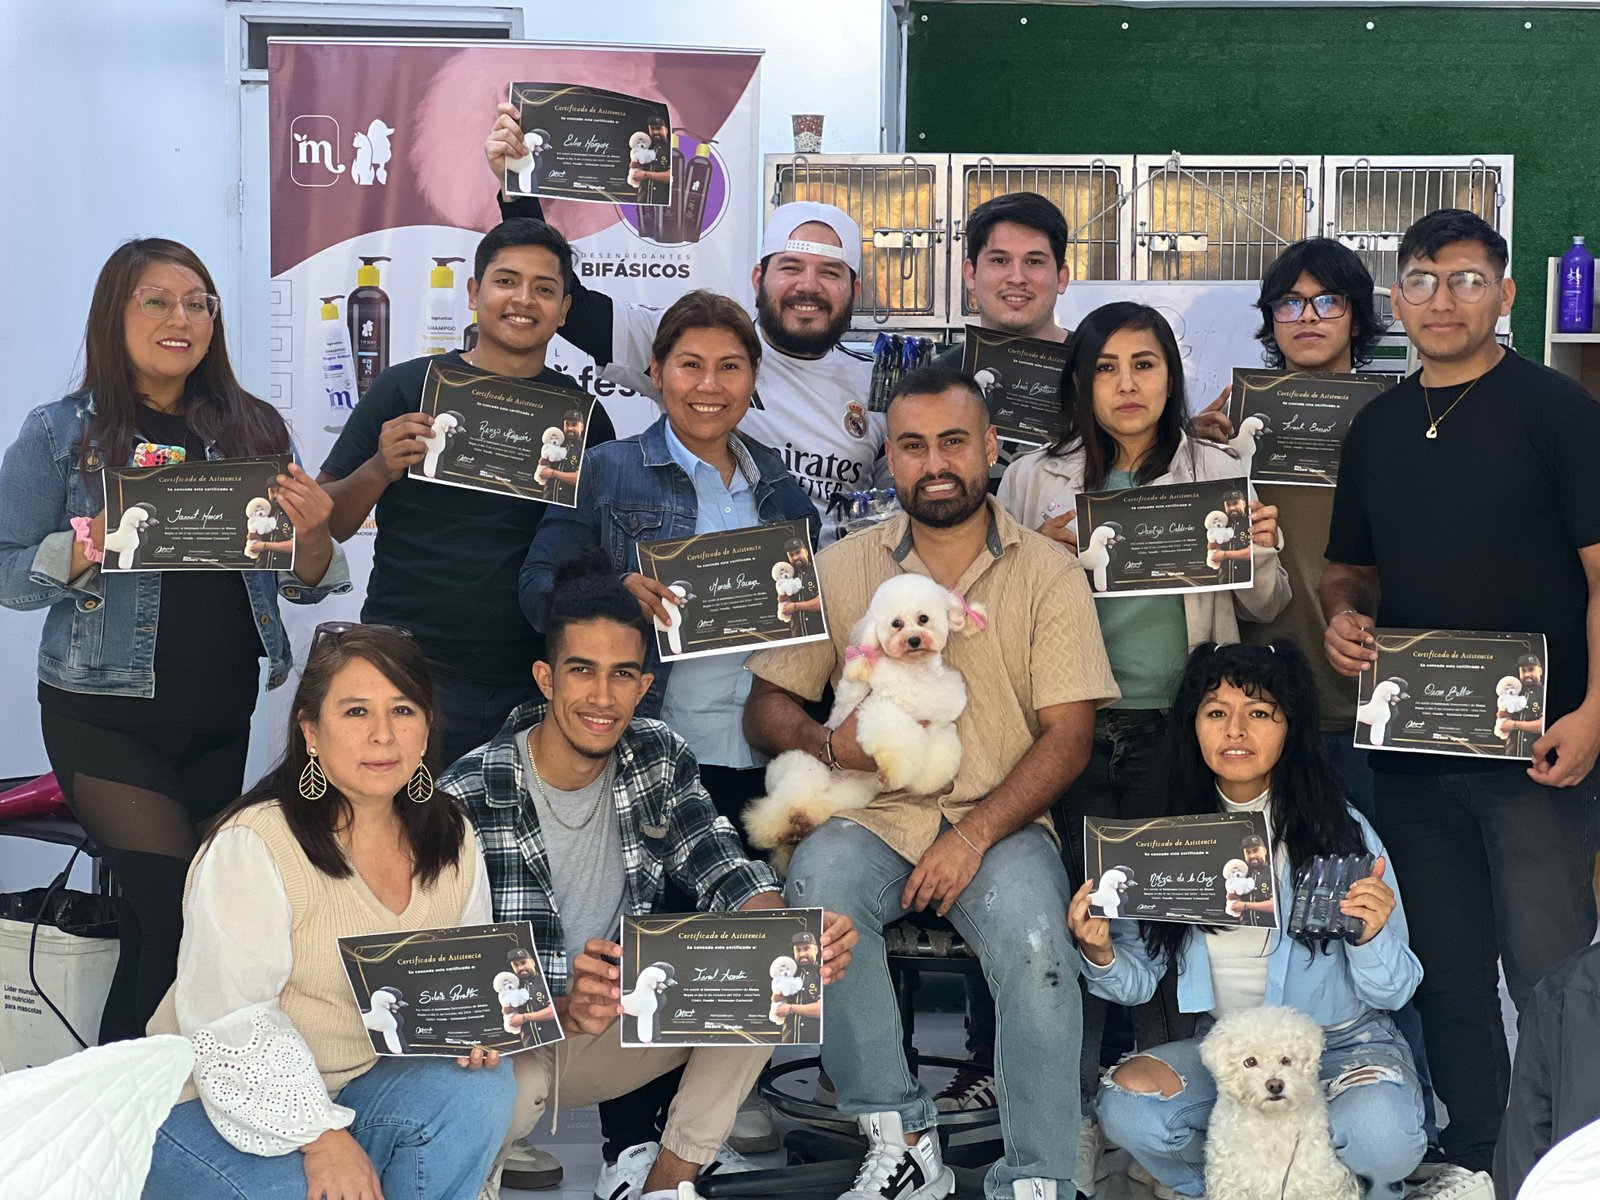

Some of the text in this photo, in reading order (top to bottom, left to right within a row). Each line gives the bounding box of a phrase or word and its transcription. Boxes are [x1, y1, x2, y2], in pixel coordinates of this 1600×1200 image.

[582, 259, 690, 278] BIFÁSICOS
[1277, 390, 1309, 398] Certificado
[472, 389, 504, 401] Certificado
[515, 398, 544, 409] Asistencia
[772, 442, 862, 483] irates
[159, 476, 196, 484] Certificado
[798, 476, 842, 500] ETTER
[687, 550, 721, 560] Certificado
[732, 545, 761, 554] Asistencia
[1413, 651, 1450, 659] Certificado
[1136, 840, 1172, 848] Certificado
[398, 956, 436, 965] Certificado
[17, 1006, 42, 1014] mascotas
